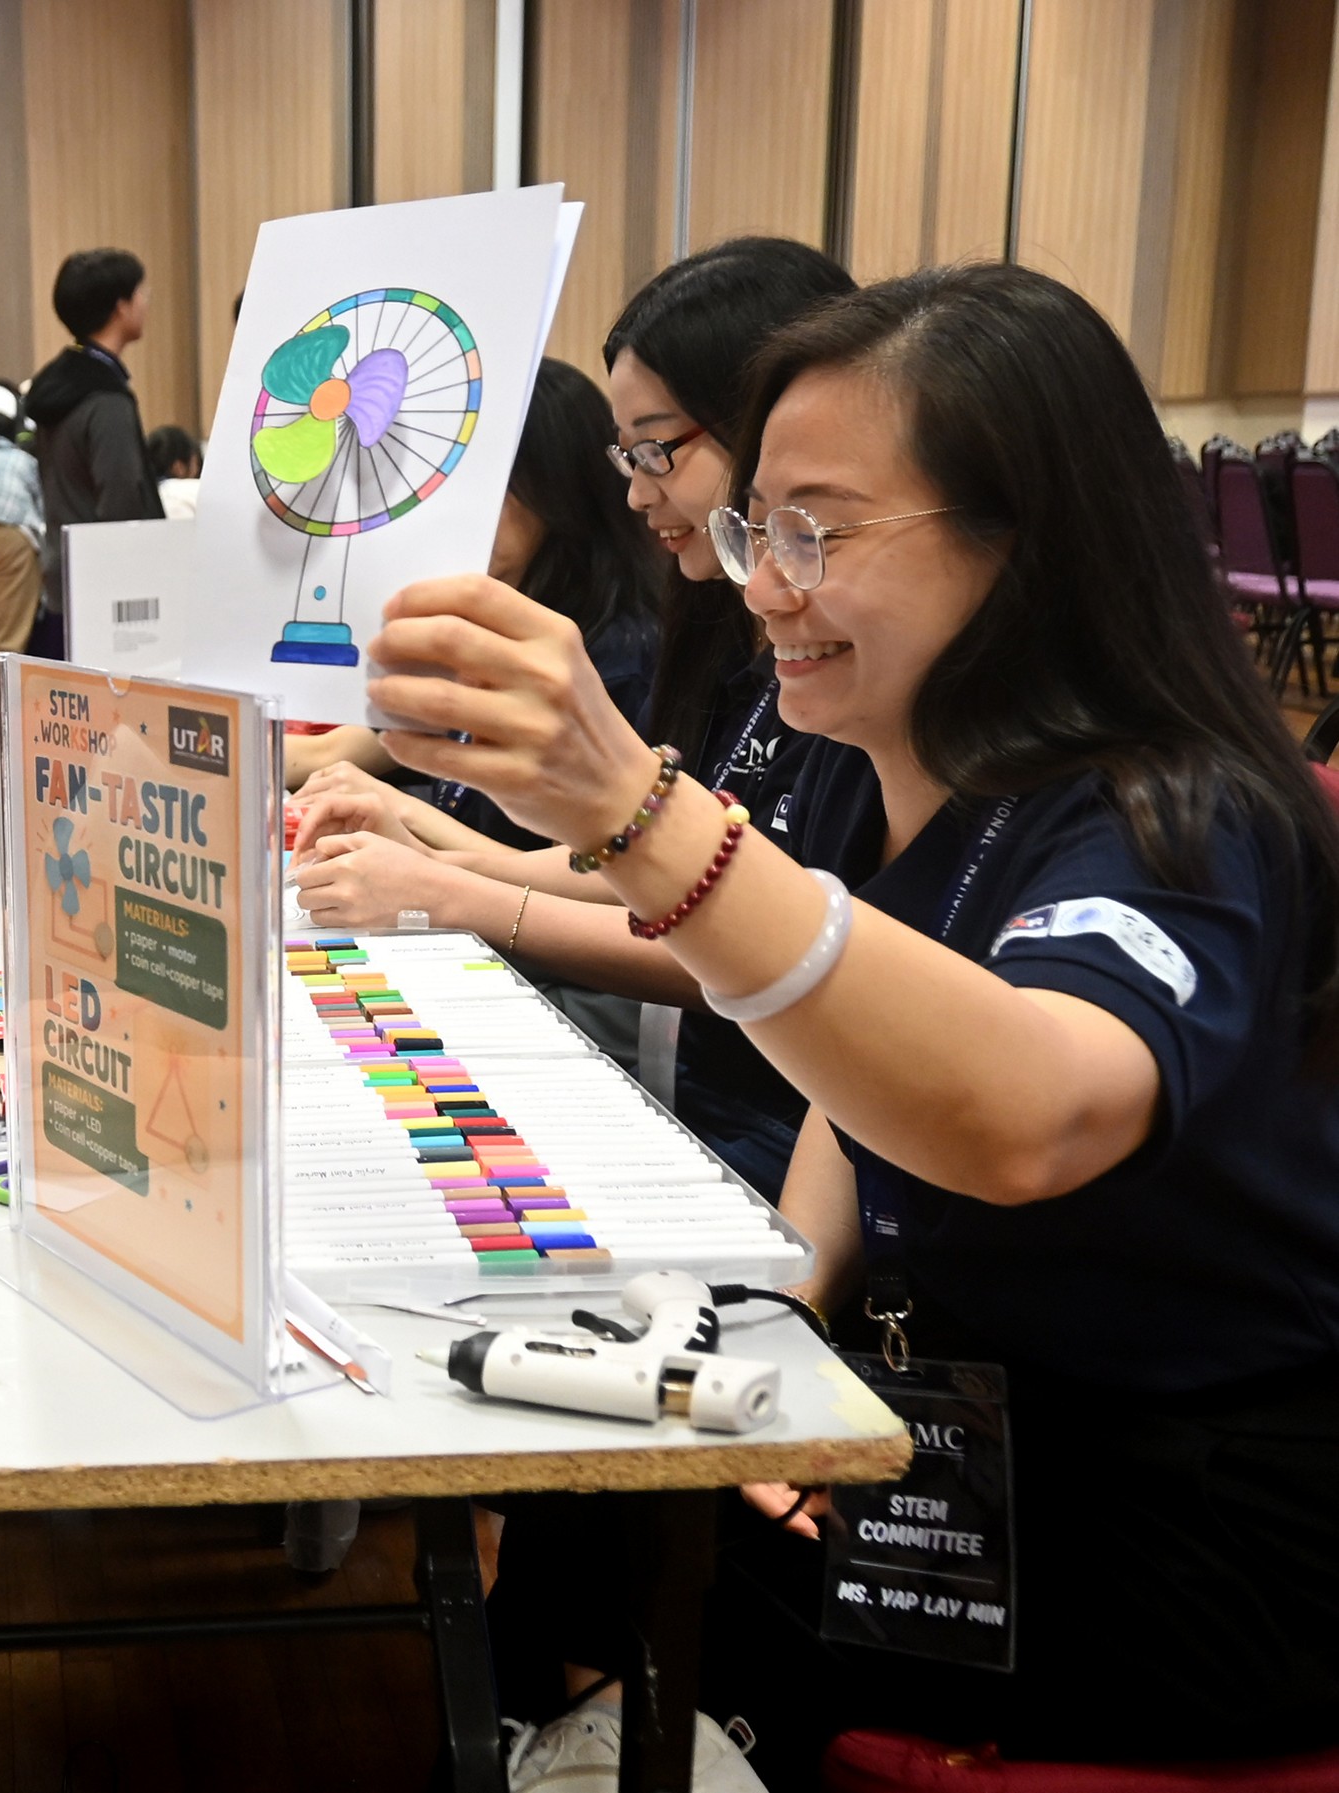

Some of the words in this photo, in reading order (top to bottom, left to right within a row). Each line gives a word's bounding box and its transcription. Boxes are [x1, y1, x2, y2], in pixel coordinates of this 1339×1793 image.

[49, 689, 89, 722] STEM
[41, 719, 117, 757] WORKSHOP
[173, 717, 224, 758] UTAR
[731, 691, 771, 761] MATHEMATICS
[35, 756, 207, 847] FAN-TASTIC
[118, 836, 227, 909] CIRCUIT
[124, 901, 190, 938] MATERIALS:
[130, 931, 158, 952] paper
[168, 944, 197, 965] motor
[131, 955, 148, 971] coin
[202, 974, 224, 1000] tape
[45, 964, 101, 1032] LED
[43, 1018, 132, 1094] CIRCUIT
[48, 1072, 104, 1112] MATERIALS:
[53, 1101, 77, 1121] paper
[85, 1113, 102, 1135] LED
[54, 1120, 71, 1138] coin
[295, 1171, 327, 1180] Marker
[330, 1170, 353, 1178] Paint
[889, 1494, 949, 1523] STEM
[858, 1519, 984, 1557] COMMITTEE
[837, 1580, 873, 1605] MS.
[880, 1586, 919, 1608] YAP
[923, 1593, 963, 1617] LAY
[966, 1601, 1005, 1627] MIN
